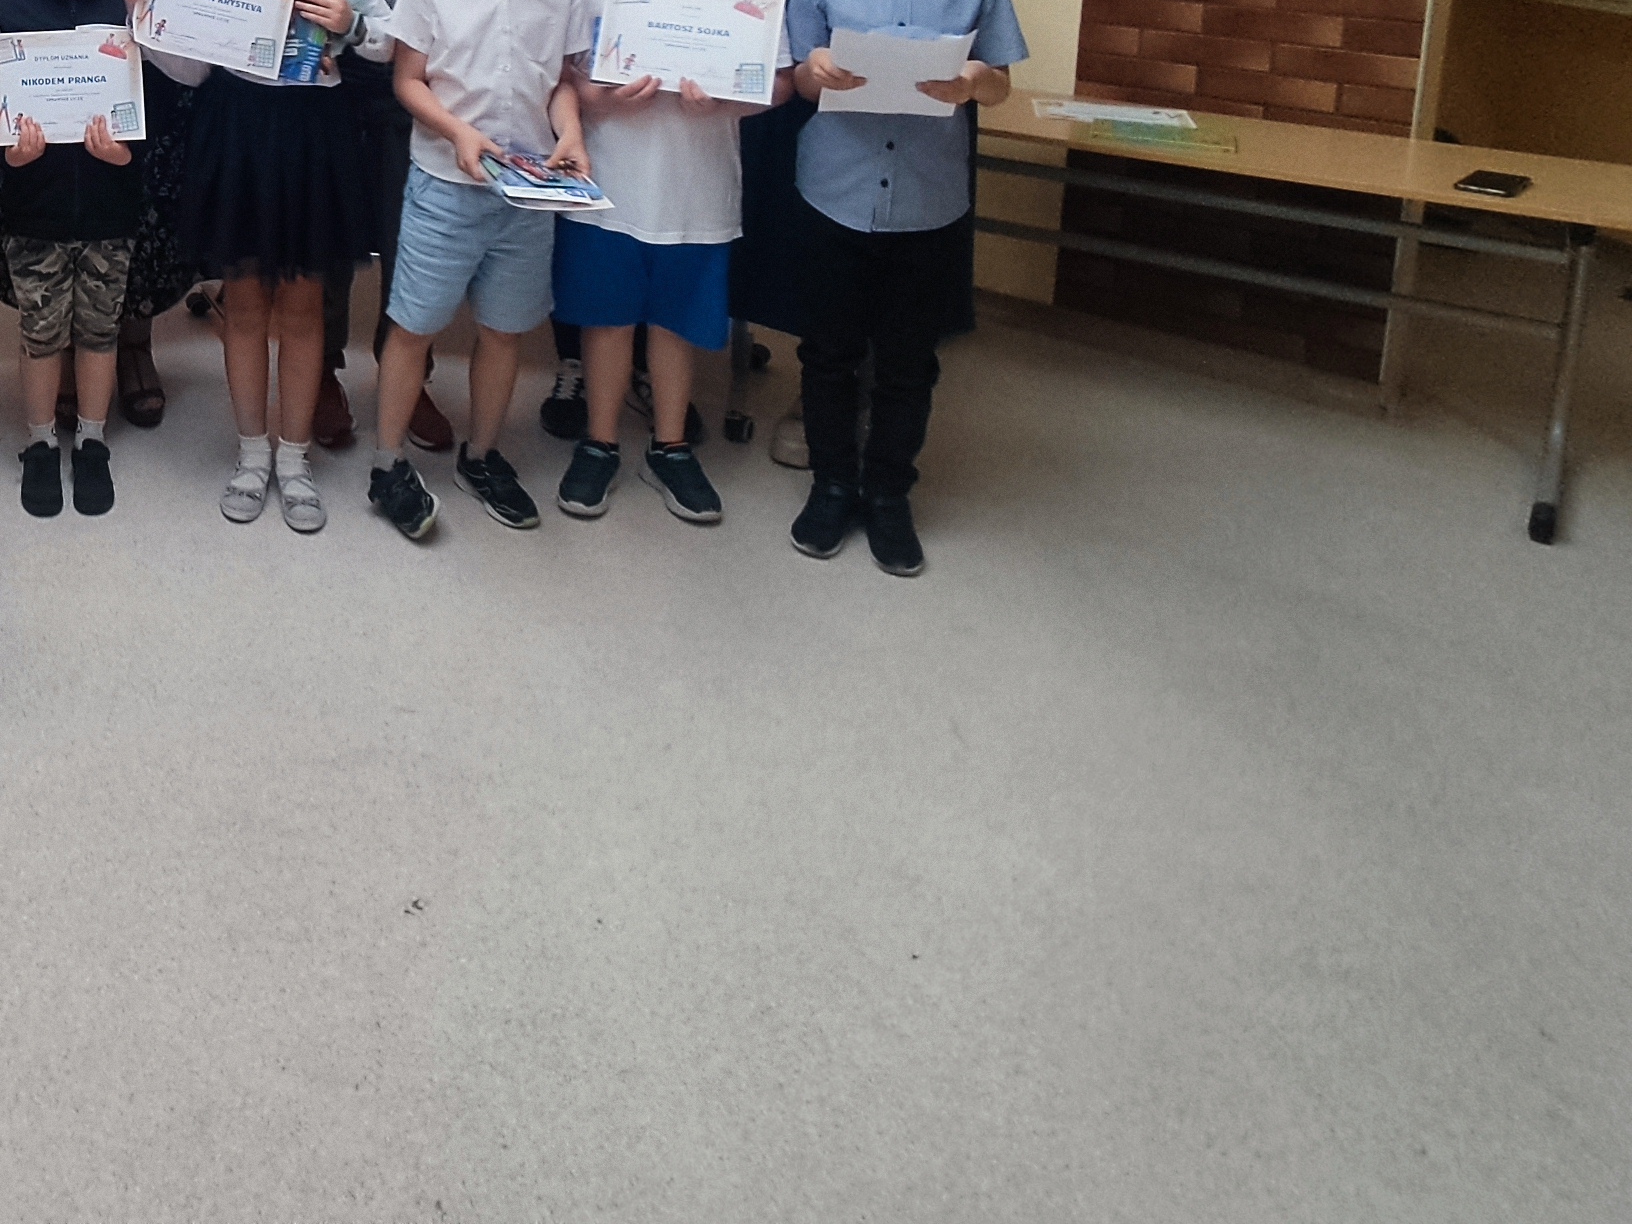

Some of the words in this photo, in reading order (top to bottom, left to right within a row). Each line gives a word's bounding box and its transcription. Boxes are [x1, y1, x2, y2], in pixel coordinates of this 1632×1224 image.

[648, 21, 693, 33] BARTOSZ
[21, 77, 65, 86] NIKODEM
[68, 75, 107, 84] PRANGA
